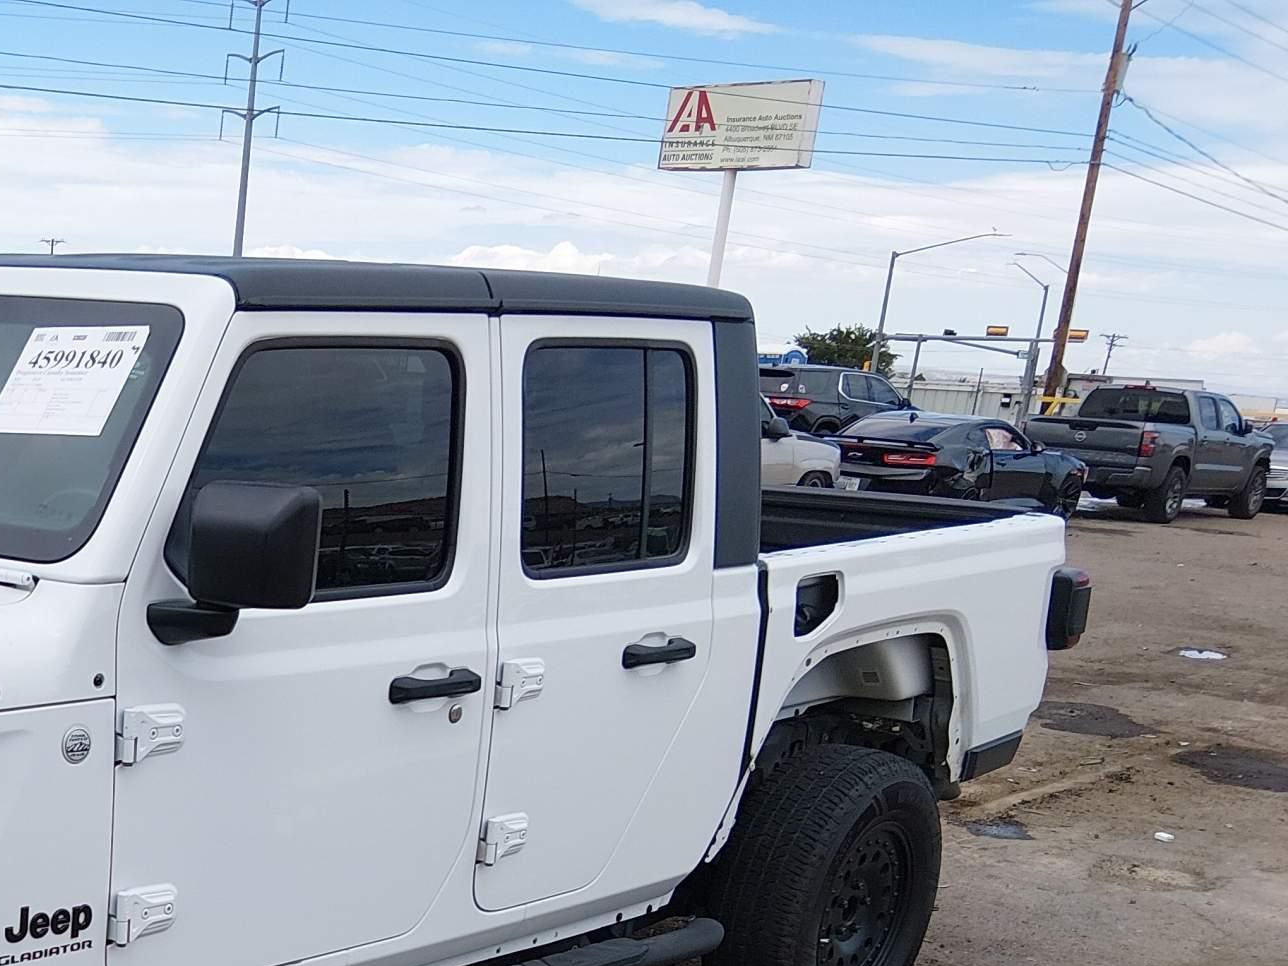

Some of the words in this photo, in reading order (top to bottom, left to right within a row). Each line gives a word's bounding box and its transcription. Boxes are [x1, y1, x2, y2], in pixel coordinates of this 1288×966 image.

[726, 115, 756, 123] Insurance
[774, 113, 802, 121] Auctions
[664, 139, 716, 149] INSURANCE
[662, 153, 680, 162] AUTO
[681, 152, 714, 162] AUCTIONS
[28, 349, 124, 369] 45991840
[4, 903, 93, 944] Jeep
